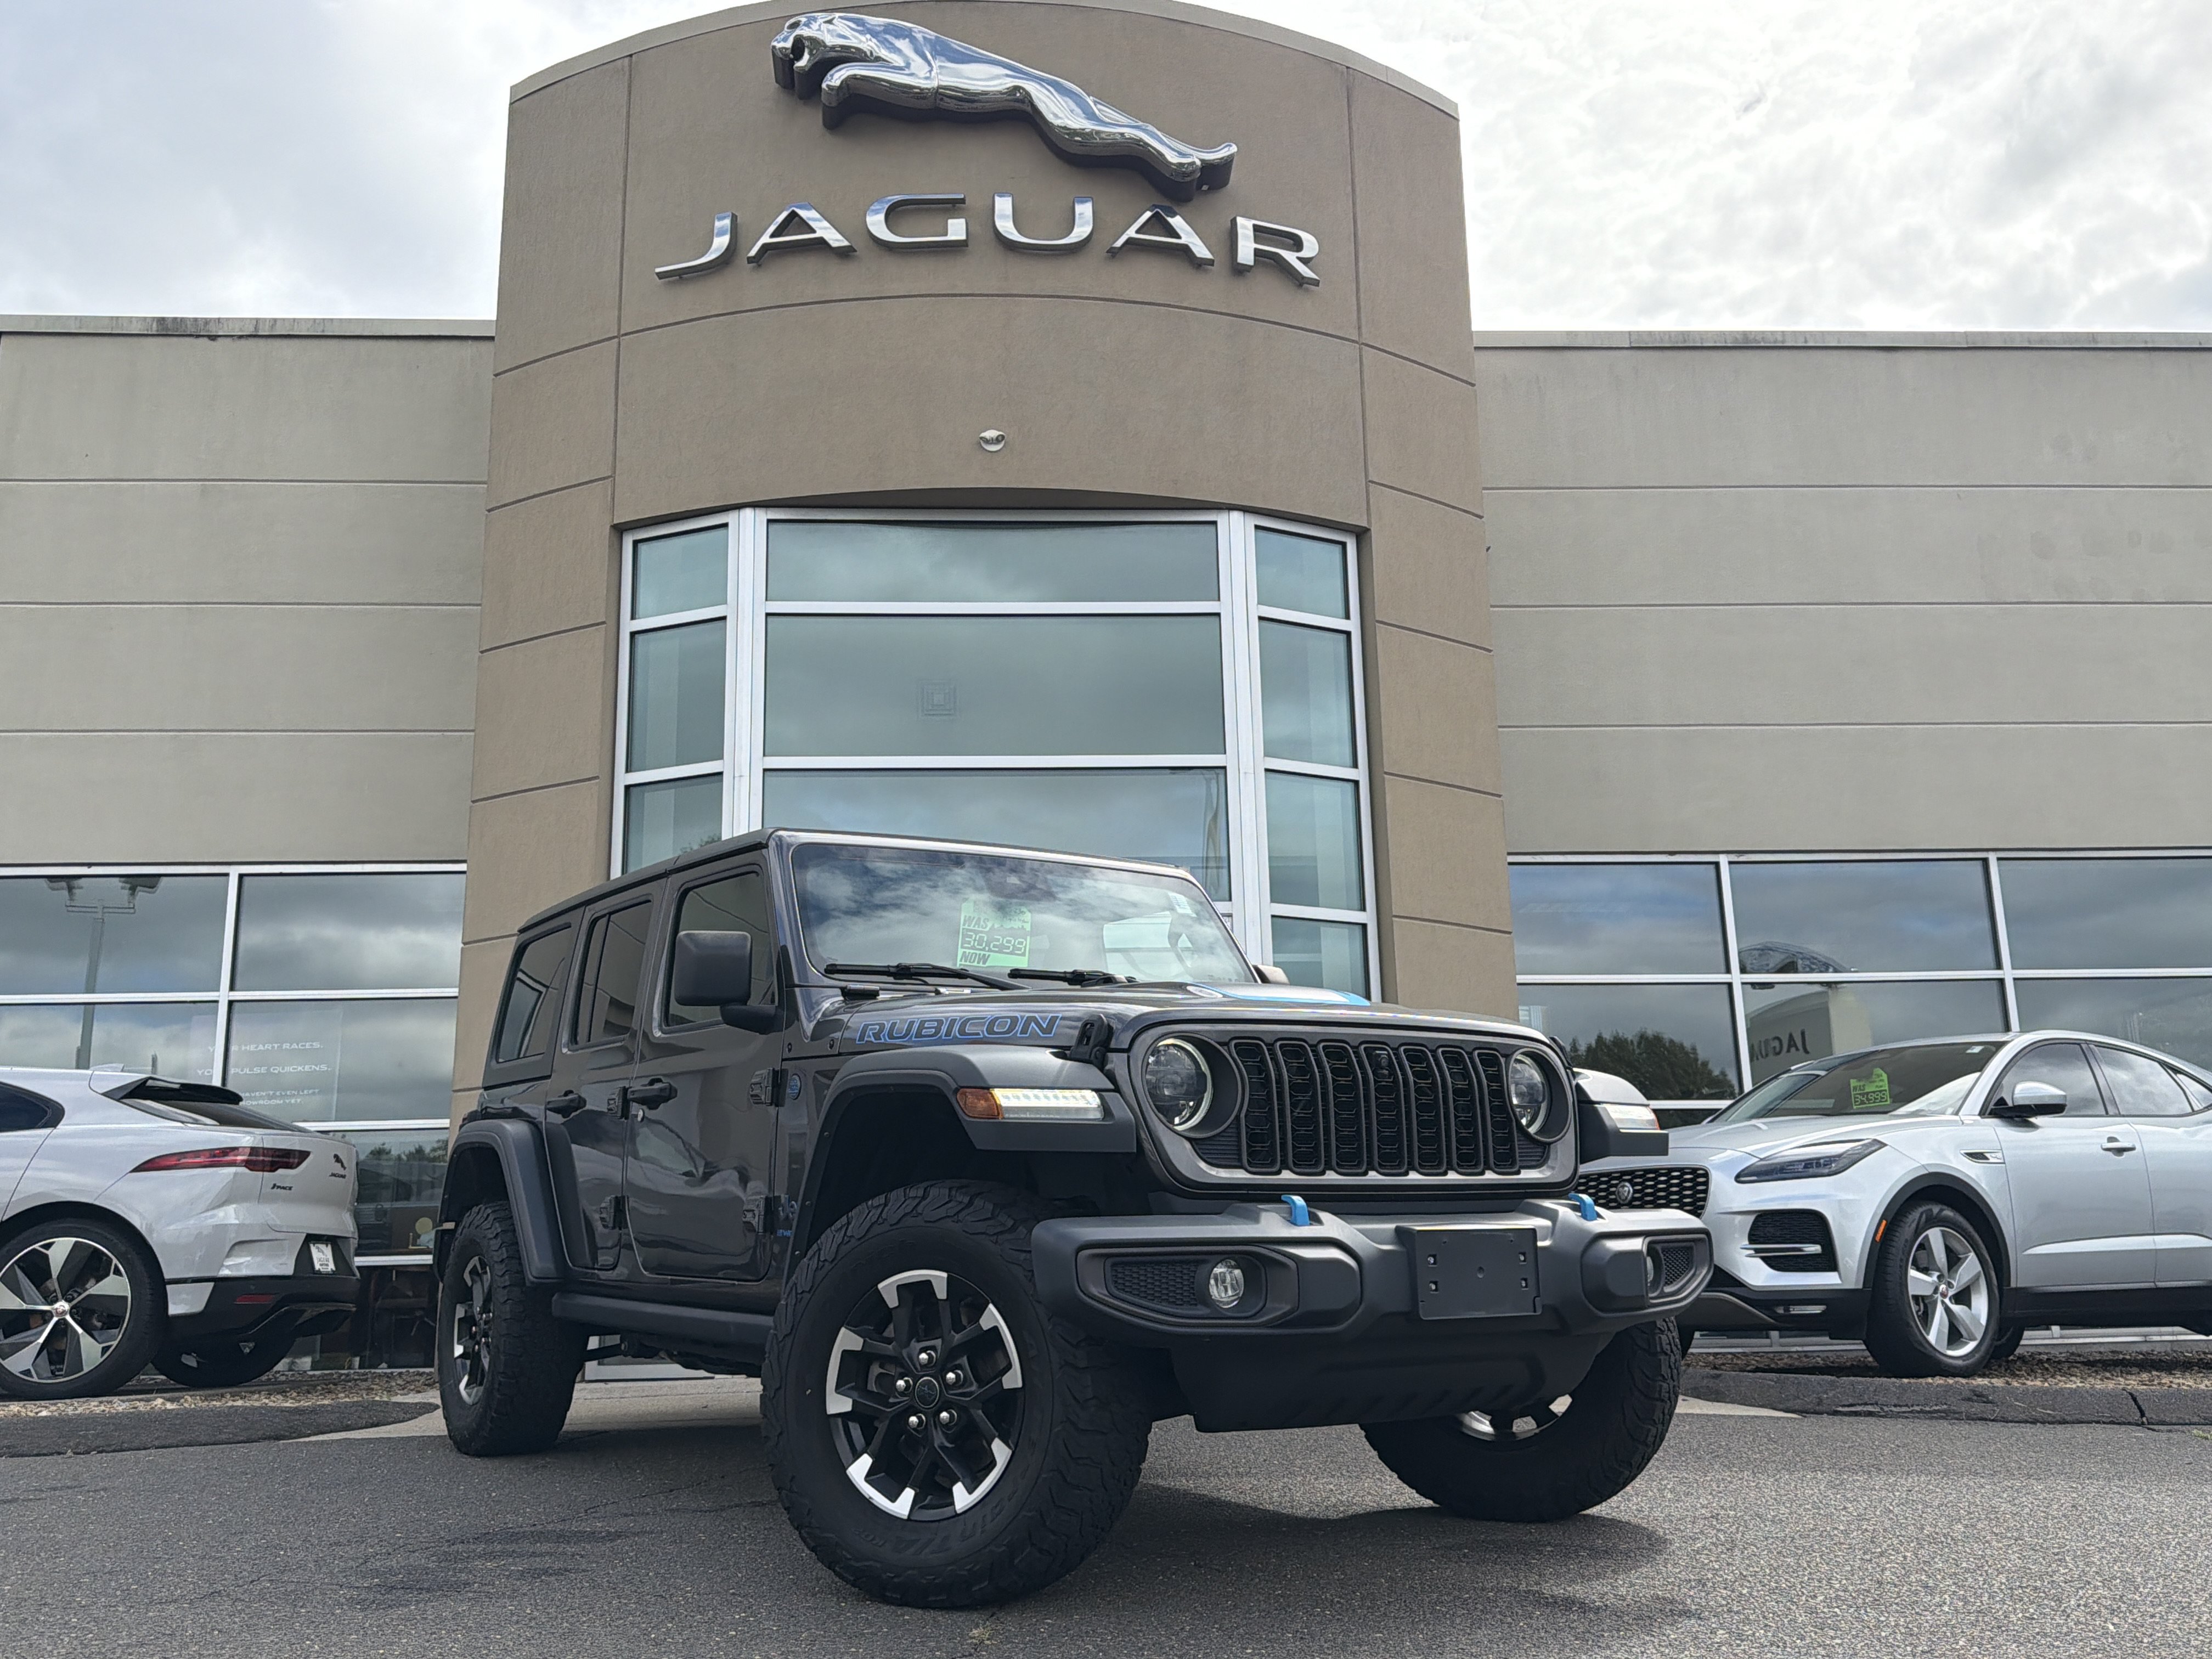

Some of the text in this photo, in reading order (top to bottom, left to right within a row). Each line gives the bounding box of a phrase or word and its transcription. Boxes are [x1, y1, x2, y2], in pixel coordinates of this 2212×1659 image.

[654, 193, 1321, 287] JAGUAR
[962, 915, 989, 930] WAS
[960, 951, 990, 966] NOW
[855, 1013, 1062, 1044] RUBICON
[208, 1044, 239, 1052] YR
[270, 1064, 332, 1073] QUICKENS.
